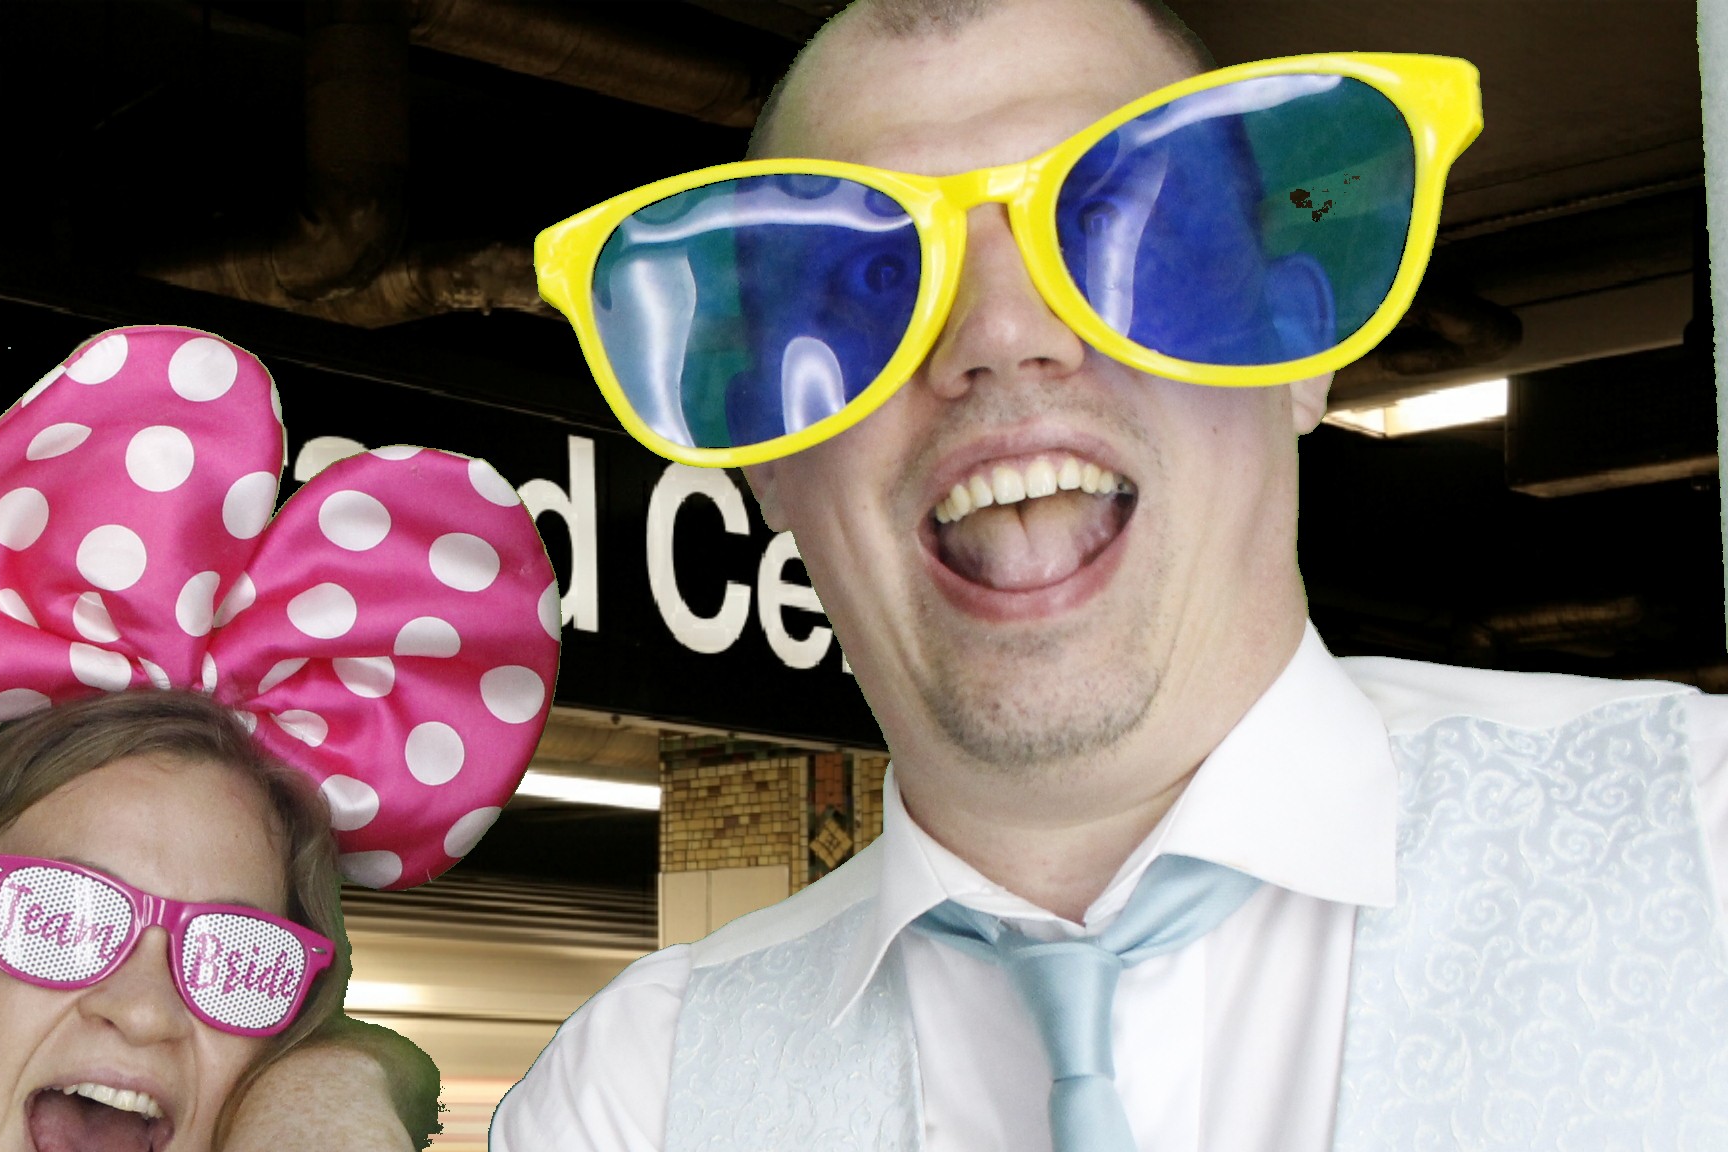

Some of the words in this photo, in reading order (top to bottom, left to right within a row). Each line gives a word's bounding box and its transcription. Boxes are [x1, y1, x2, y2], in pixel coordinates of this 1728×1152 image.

[645, 461, 856, 674] Ce
[2, 879, 120, 960] Team
[187, 931, 296, 1000] Bride
